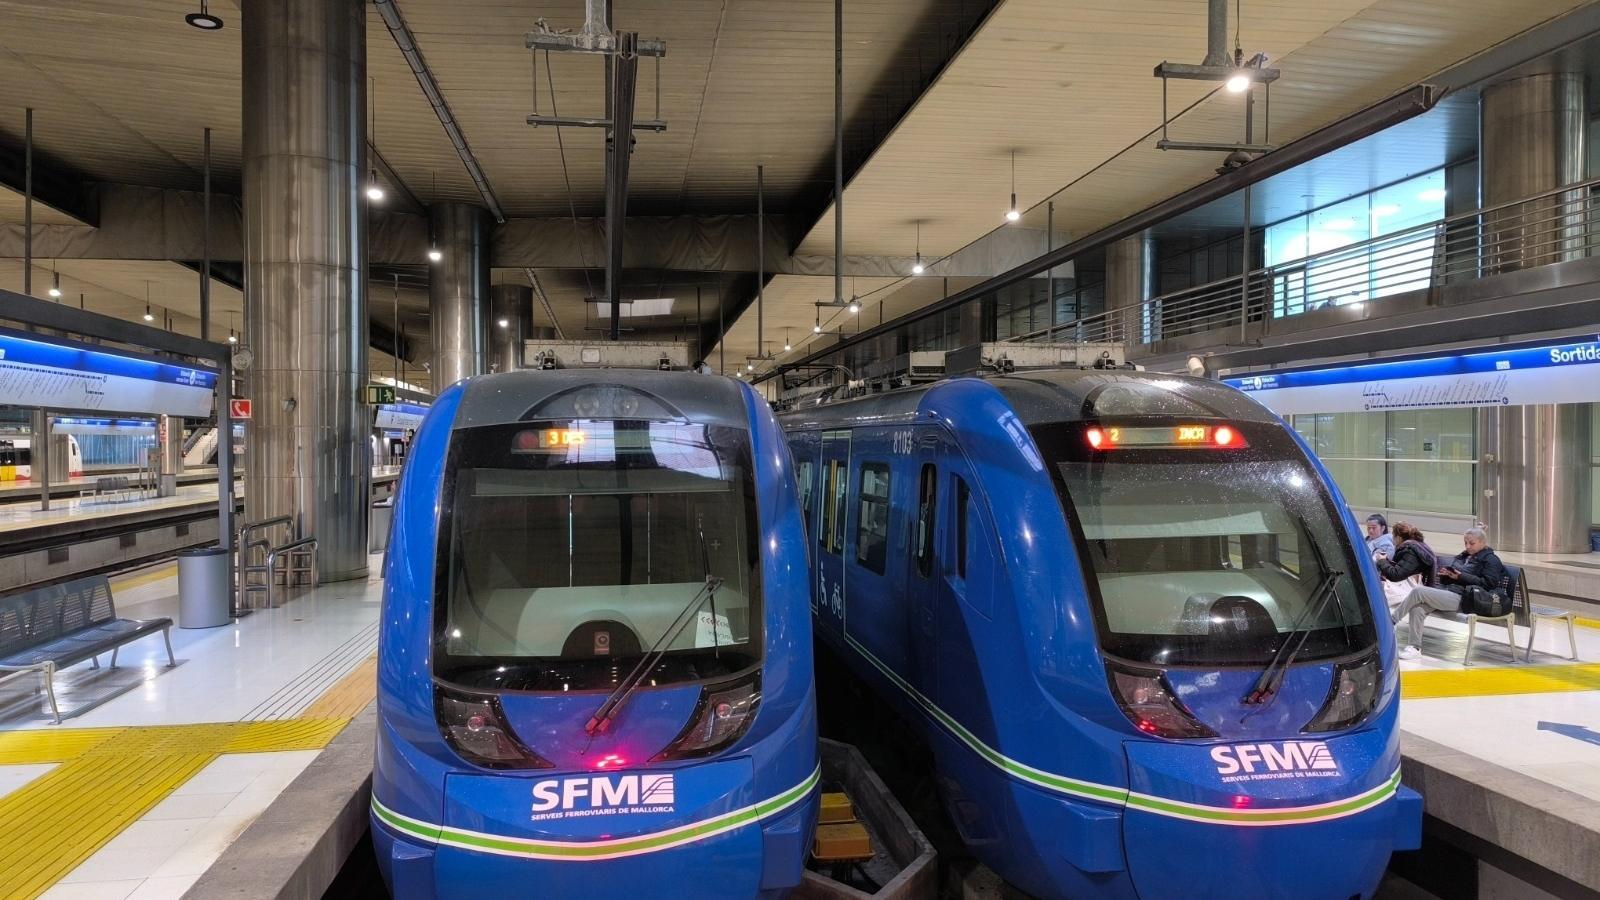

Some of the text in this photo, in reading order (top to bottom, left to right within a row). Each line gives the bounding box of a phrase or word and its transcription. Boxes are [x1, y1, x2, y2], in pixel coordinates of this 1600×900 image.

[549, 431, 559, 444] 3
[1110, 428, 1120, 441] 2
[893, 431, 912, 455] 8103
[1210, 742, 1308, 774] SFM
[1221, 775, 1250, 783] SERVEIS
[1250, 772, 1294, 781] FERROVIARIS
[1305, 770, 1342, 778] MALLORCA
[531, 775, 639, 812] SFM
[531, 812, 563, 821] SERVEIS
[565, 808, 616, 818] FERROVIARIS
[631, 806, 674, 814] MALLORCA
